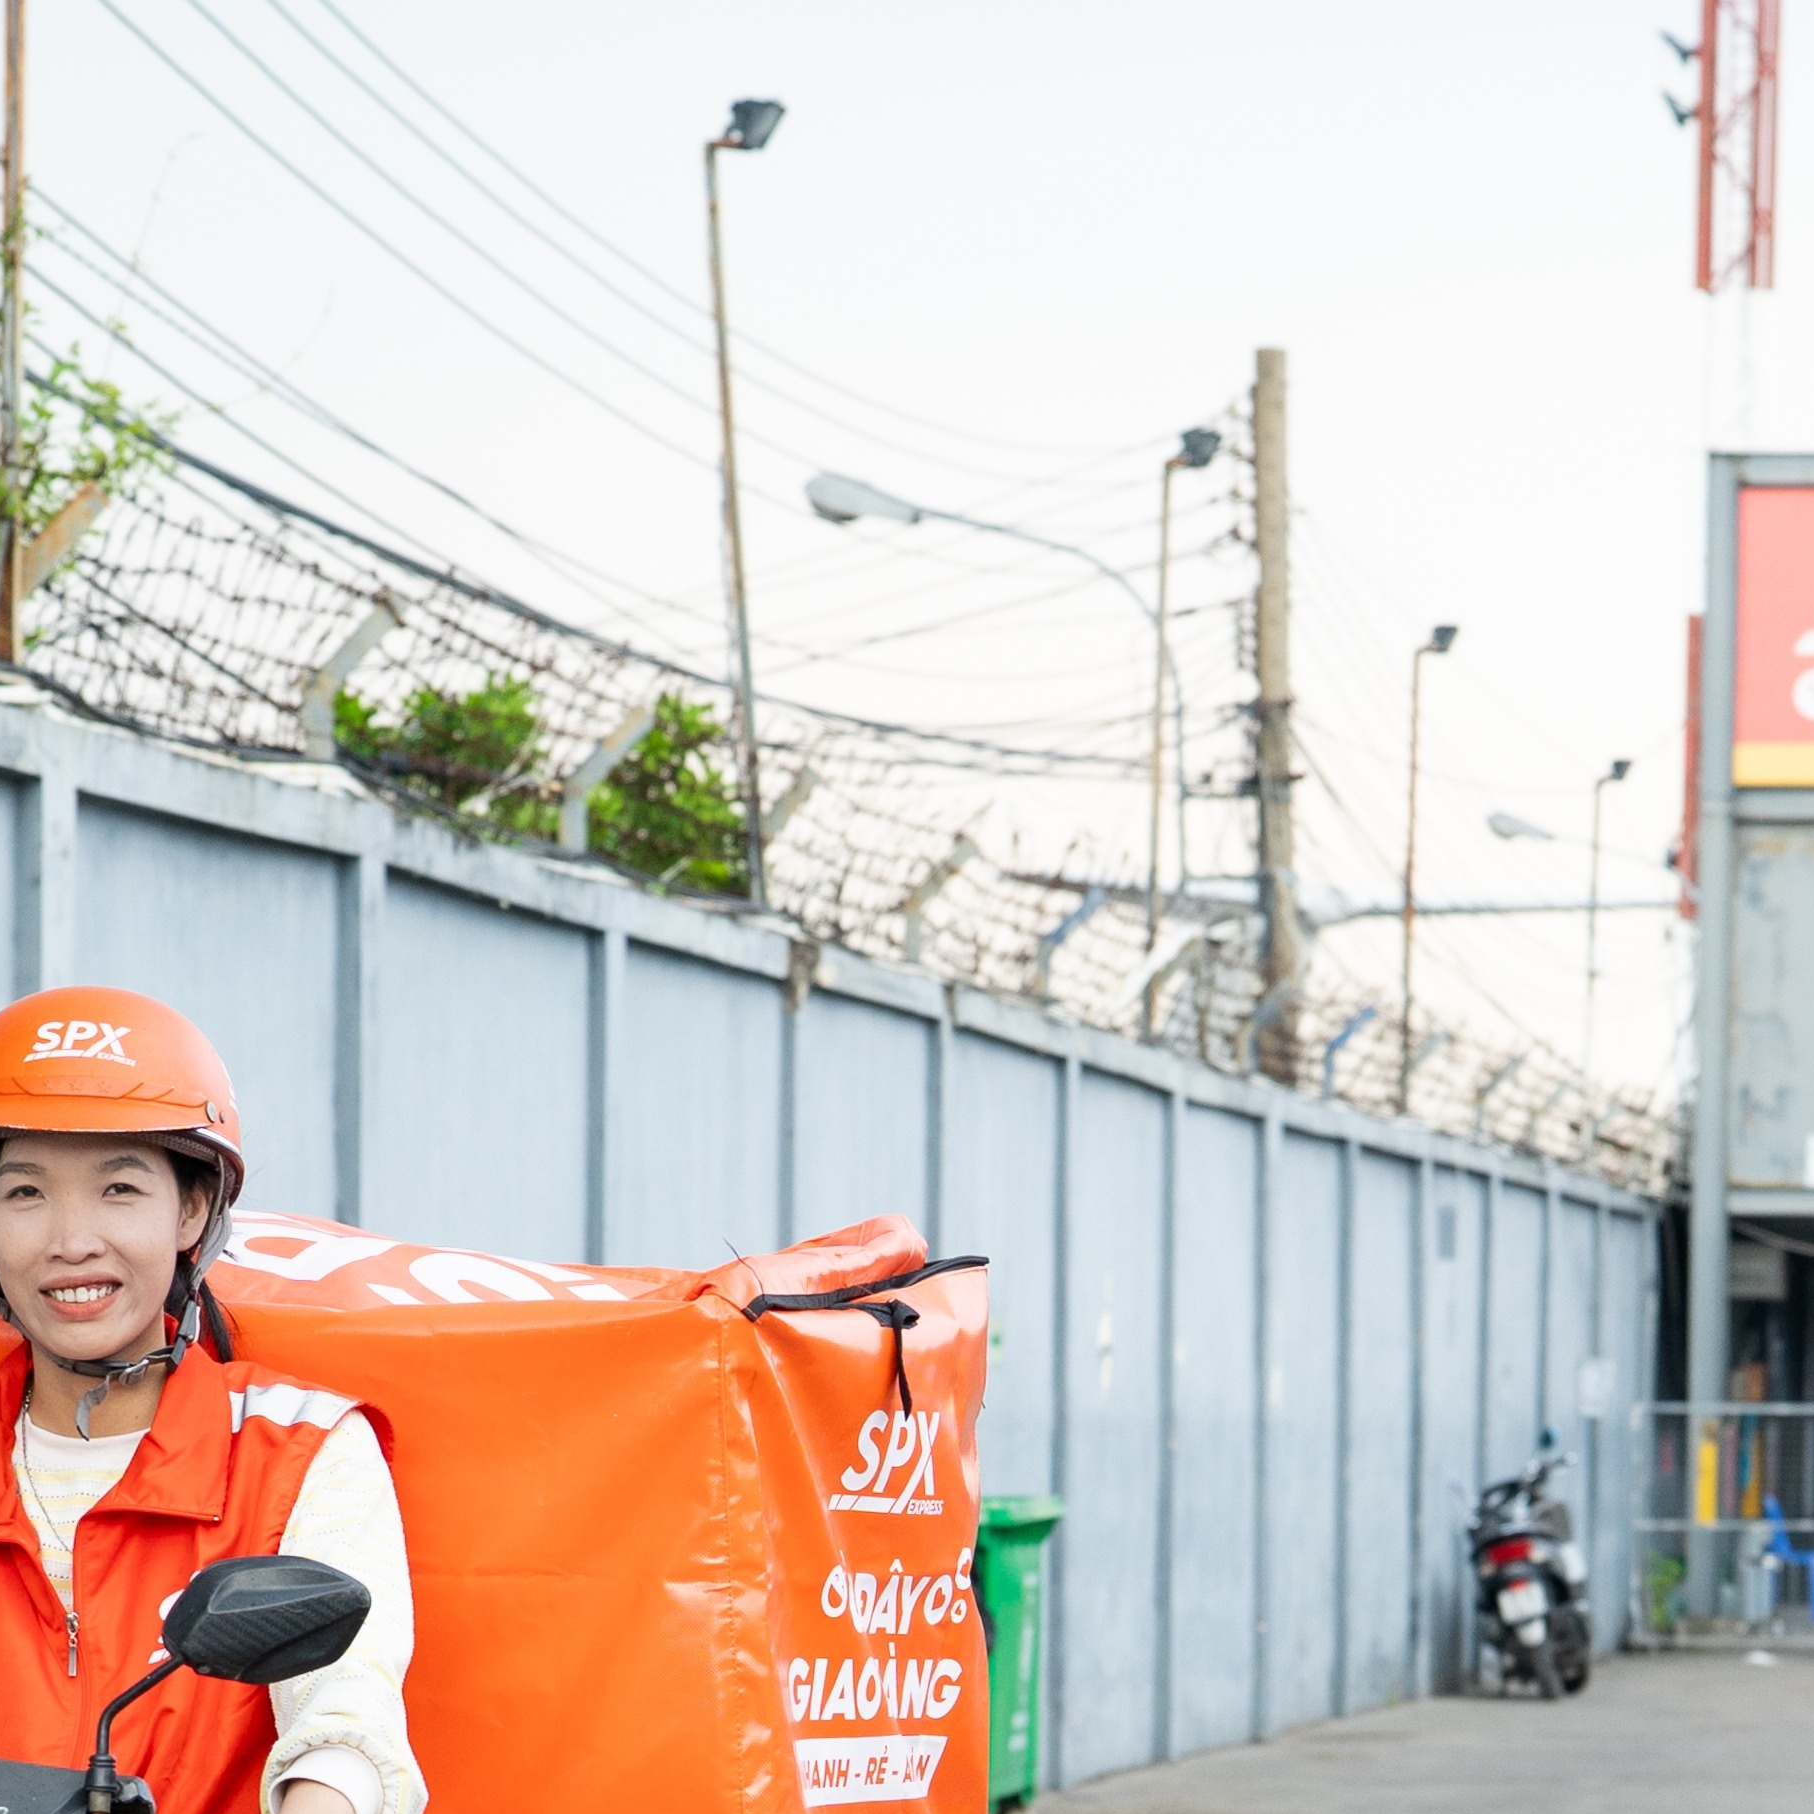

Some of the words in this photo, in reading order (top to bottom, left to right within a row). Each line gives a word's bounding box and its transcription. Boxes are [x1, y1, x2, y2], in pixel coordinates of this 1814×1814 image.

[32, 1020, 132, 1057] SPX
[840, 1409, 941, 1510] SPX
[906, 1499, 944, 1515] EXPRESS
